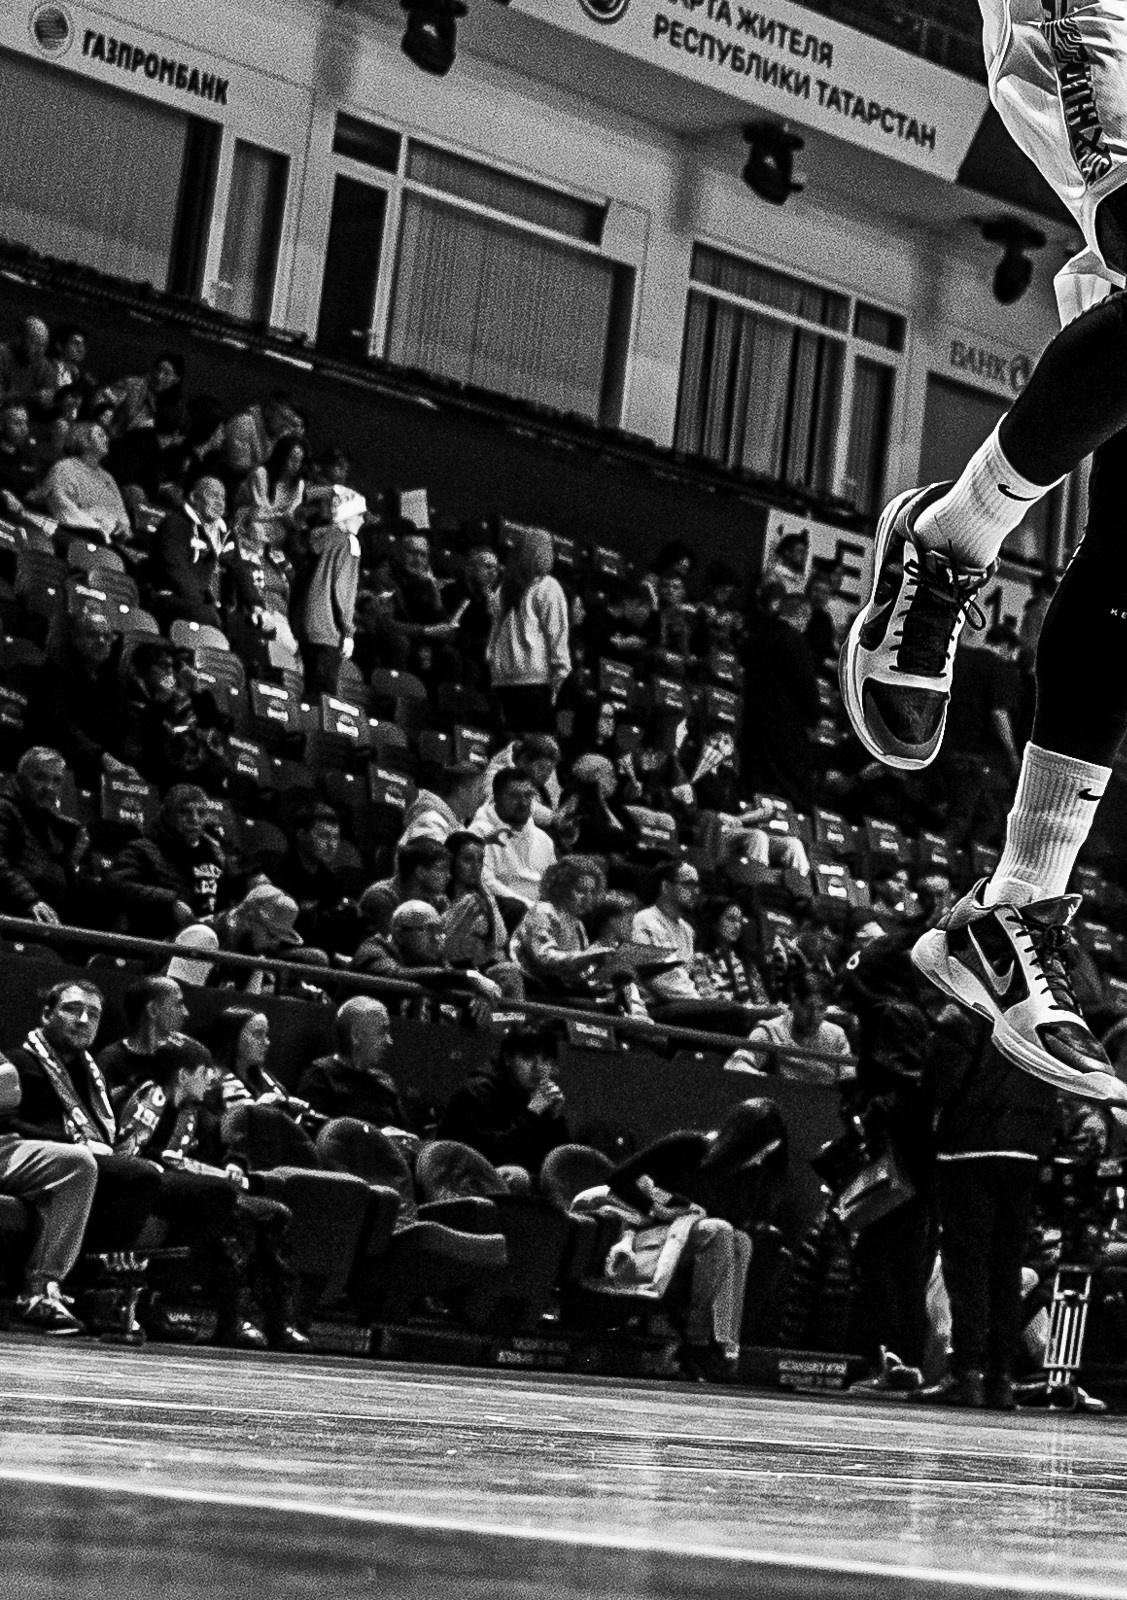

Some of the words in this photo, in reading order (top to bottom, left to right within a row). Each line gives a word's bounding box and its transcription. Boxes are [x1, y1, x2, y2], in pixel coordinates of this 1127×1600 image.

[82, 29, 229, 105] ГАЗПРОМБАНК
[736, 6, 834, 68] ЖИТЕЛЯ
[653, 13, 811, 100] РЕСПУБЛИКИ
[815, 79, 936, 151] ТАТАРСТАН
